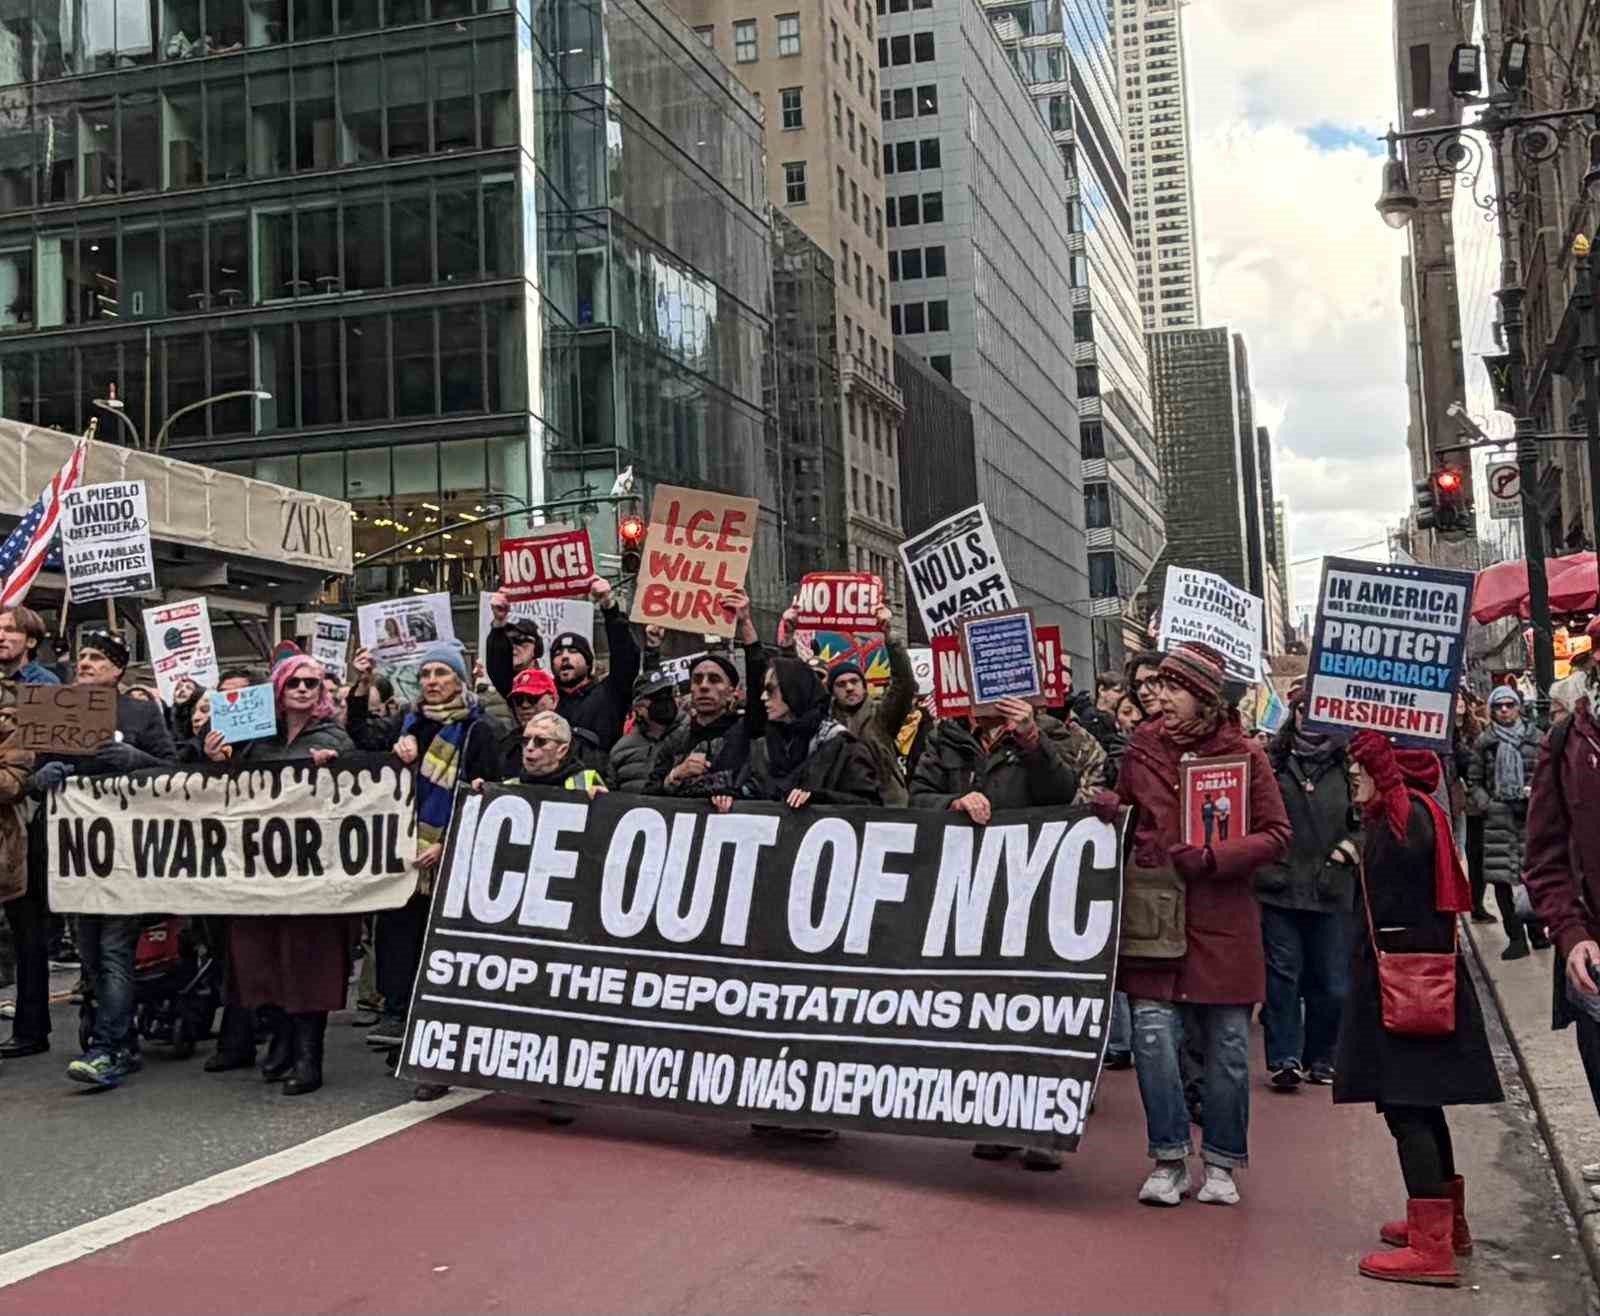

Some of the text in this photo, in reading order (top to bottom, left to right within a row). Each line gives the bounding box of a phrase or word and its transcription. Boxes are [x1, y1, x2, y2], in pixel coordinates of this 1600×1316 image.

[87, 484, 139, 502] PUEBLO
[72, 499, 134, 525] UNIDO
[664, 500, 748, 553] I.C.E.
[68, 555, 75, 564] A
[76, 550, 95, 563] LAS
[69, 555, 146, 578] MIGRANTES!
[503, 542, 588, 585] NO ICE!
[649, 551, 737, 589] WILL
[912, 532, 995, 600] NO U.S.
[799, 582, 879, 614] NO ICE!
[926, 573, 1005, 623] WAR
[1184, 584, 1246, 618] UNIDO
[1328, 601, 1457, 626] WE SHOULD NOT HAVE TO
[1329, 577, 1458, 614] IN AMERICA
[1183, 618, 1203, 629] LAS
[1322, 620, 1455, 665] PROTECT
[1320, 651, 1451, 689] DEMOCRACY
[24, 685, 109, 711] ICE
[1345, 684, 1417, 707] FROM THE
[1314, 696, 1444, 734] PRESIDENT!
[1196, 778, 1237, 791] DREAM
[58, 814, 406, 879] NO WAR FOR OIL
[442, 795, 1117, 961] ICE OUT OF NYC
[426, 950, 1104, 1037] STOP THE DEPORTATIONS NOW!
[408, 1019, 1092, 1135] ICE FUERA DE NYC! NO MÁS DEPORTACIONES!
